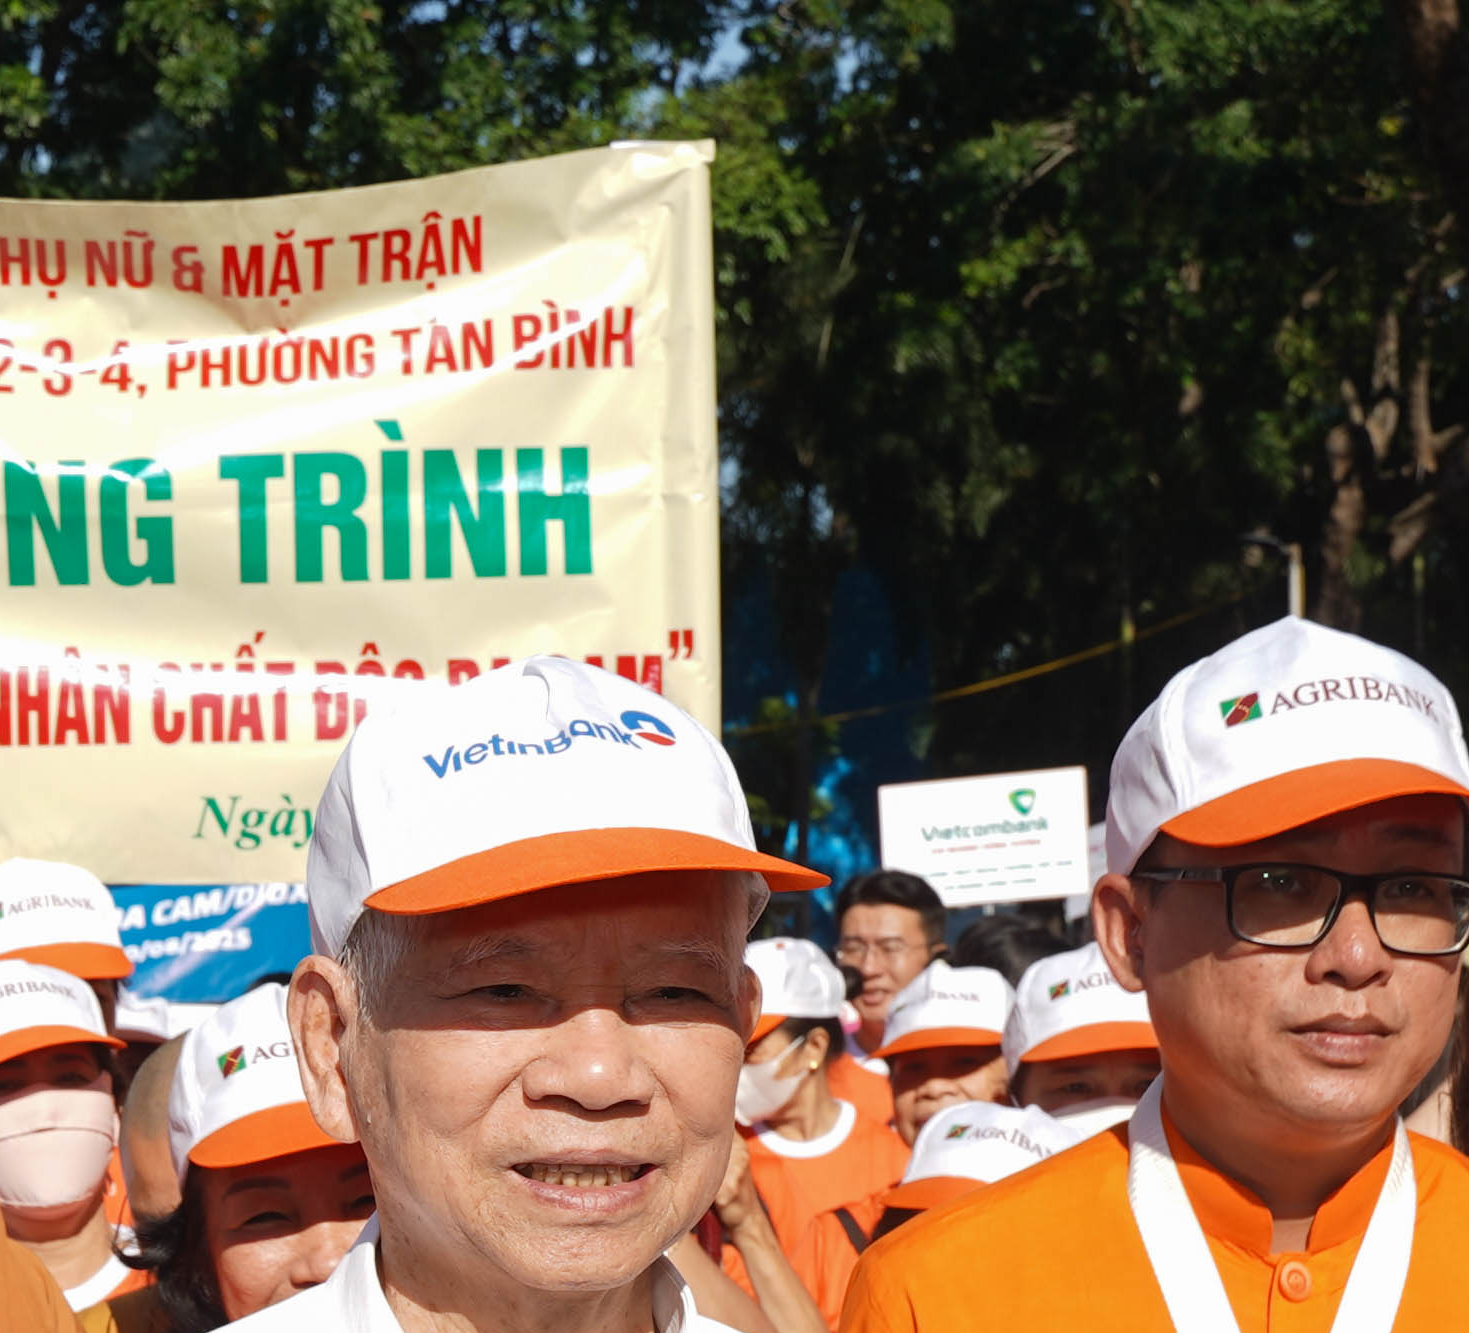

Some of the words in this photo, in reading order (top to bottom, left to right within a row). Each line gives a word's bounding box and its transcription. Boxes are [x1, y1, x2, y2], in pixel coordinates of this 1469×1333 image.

[84, 231, 155, 289] NỮ
[171, 245, 204, 293] &
[220, 229, 334, 306] MẶT
[349, 211, 483, 289] TRẬN
[167, 329, 374, 390] PHƯỜNG
[512, 300, 635, 370] BÌNH
[218, 420, 594, 584] TRÌNH
[1268, 676, 1439, 721] AGRIBANK
[422, 720, 642, 778] VietinBank
[7, 895, 96, 917] AGRIBANK
